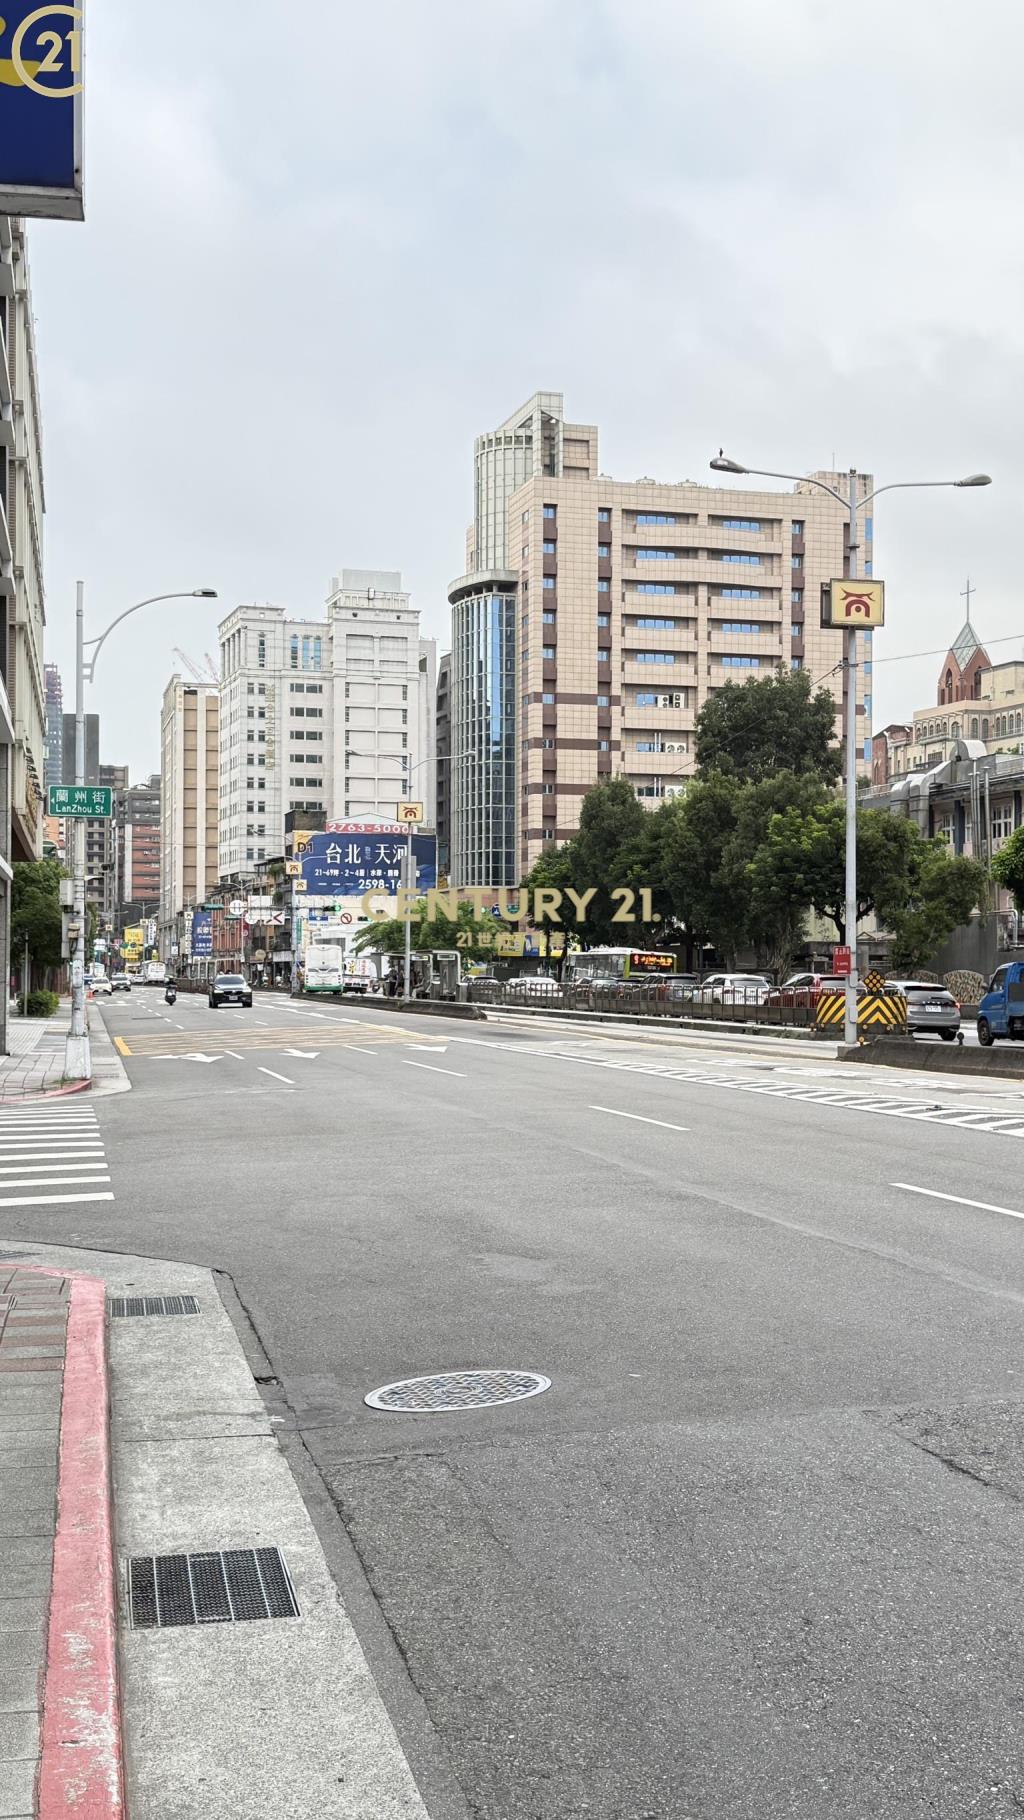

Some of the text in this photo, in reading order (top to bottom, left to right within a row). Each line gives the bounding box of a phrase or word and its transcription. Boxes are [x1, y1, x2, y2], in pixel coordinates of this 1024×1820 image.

[56, 790, 105, 804] 蘭州街
[56, 804, 92, 813] LanZhou
[327, 823, 409, 833] 2763-5000
[297, 842, 314, 853] D1
[358, 879, 402, 889] 2598-16
